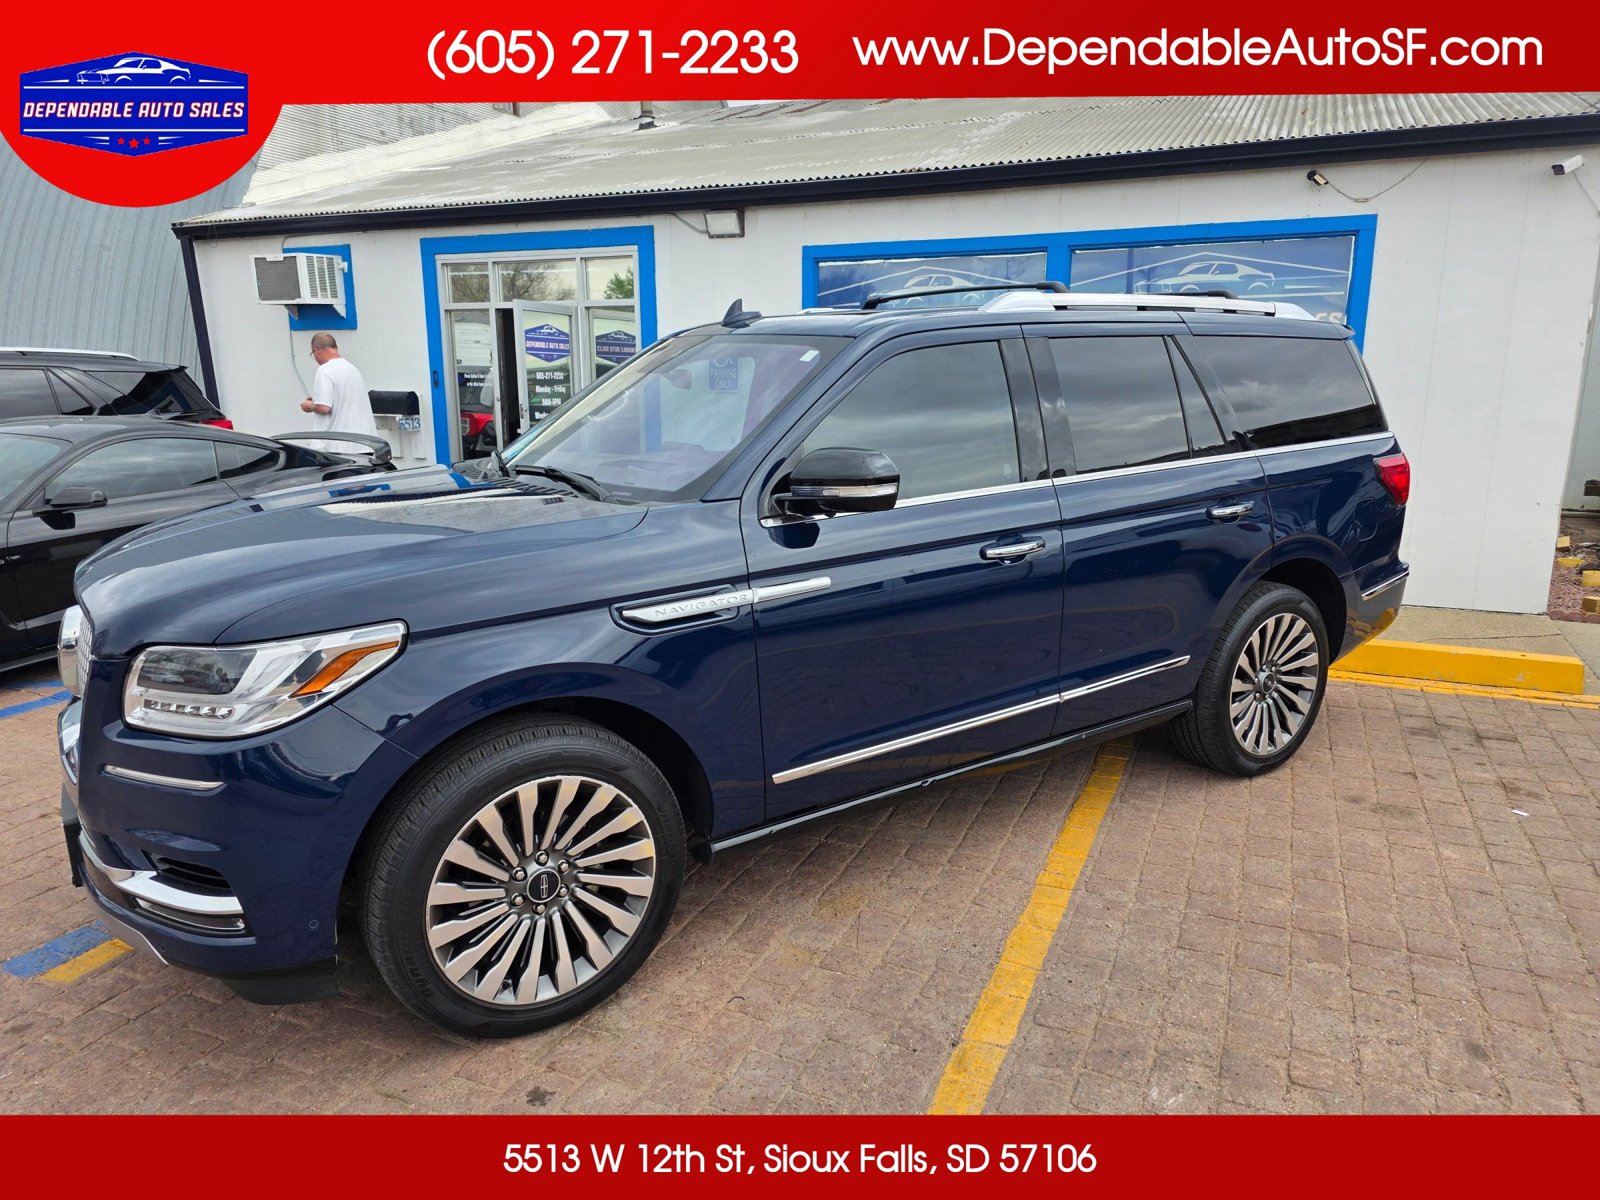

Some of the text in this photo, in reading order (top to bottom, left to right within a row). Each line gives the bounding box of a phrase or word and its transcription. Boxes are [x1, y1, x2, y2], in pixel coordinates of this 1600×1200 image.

[711, 367, 737, 378] PARKING
[715, 378, 732, 389] ONLY
[398, 417, 421, 430] 5513
[655, 593, 748, 616] NAVIGATOR
